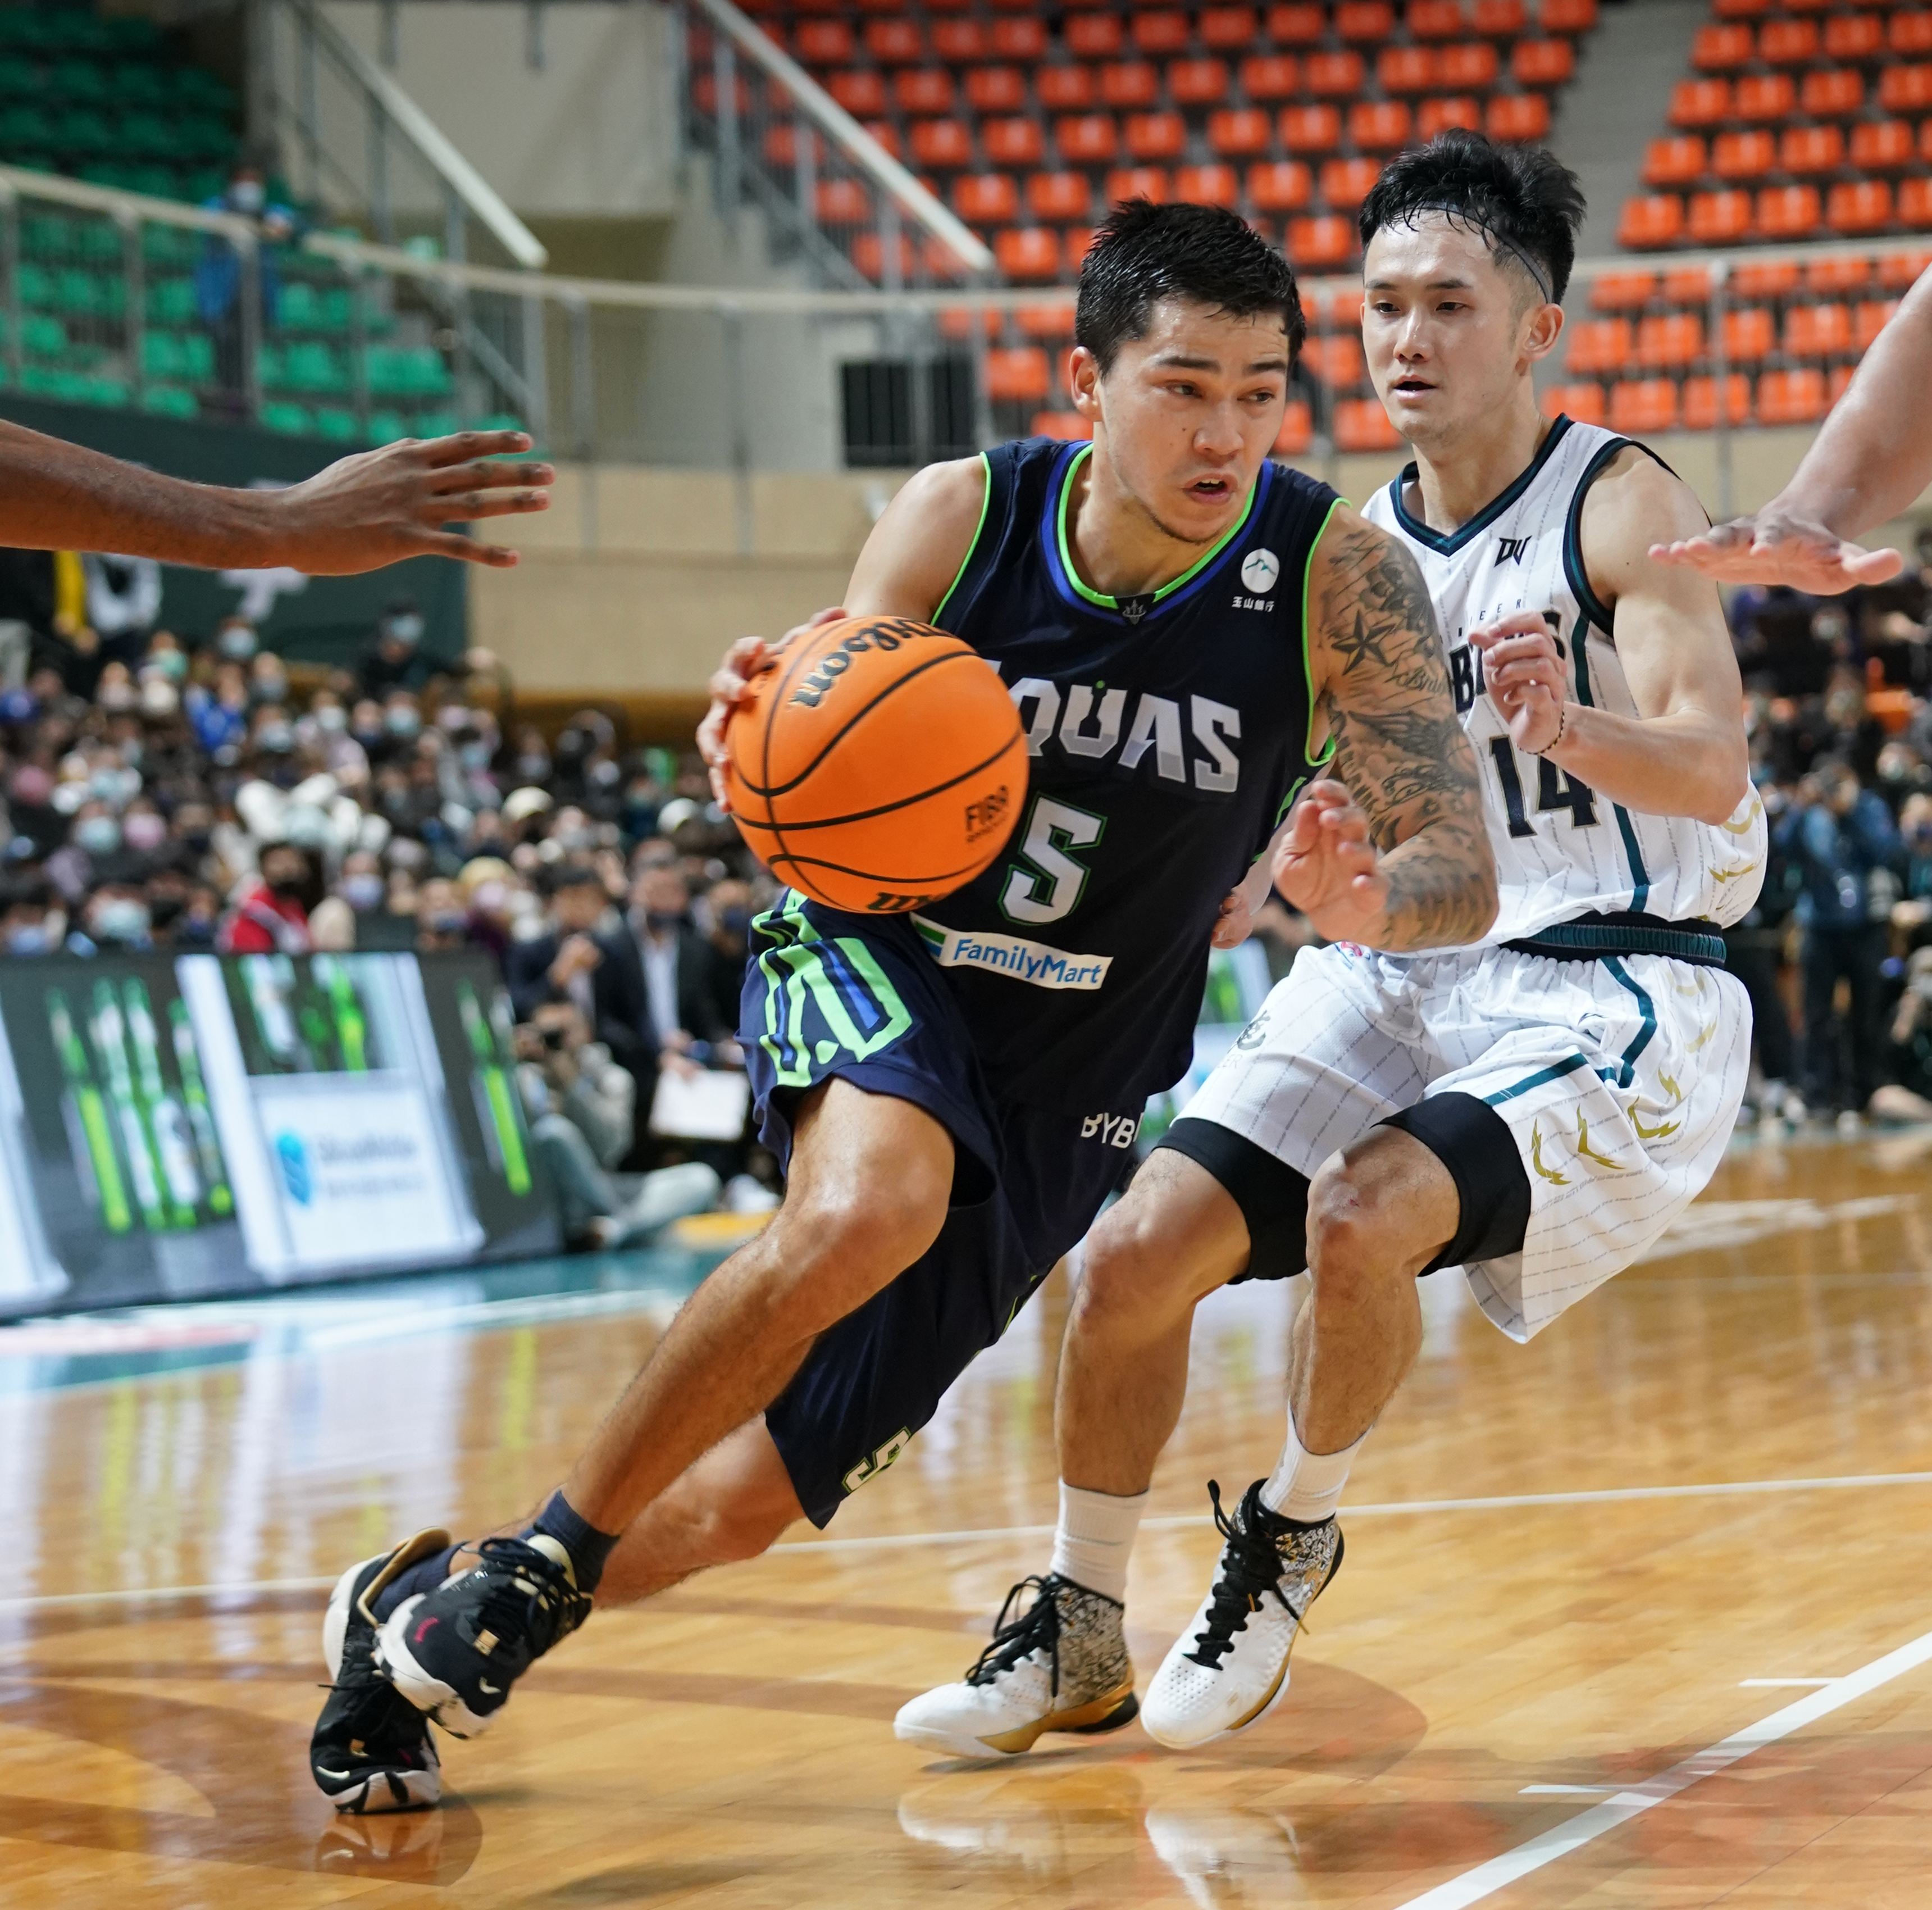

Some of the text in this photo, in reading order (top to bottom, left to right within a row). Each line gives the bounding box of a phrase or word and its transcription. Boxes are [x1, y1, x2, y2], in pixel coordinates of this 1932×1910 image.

[980, 658, 1242, 793] QUAS
[1489, 734, 1602, 839] 14
[997, 791, 1107, 926] 5
[953, 938, 1103, 984] FamilyMart
